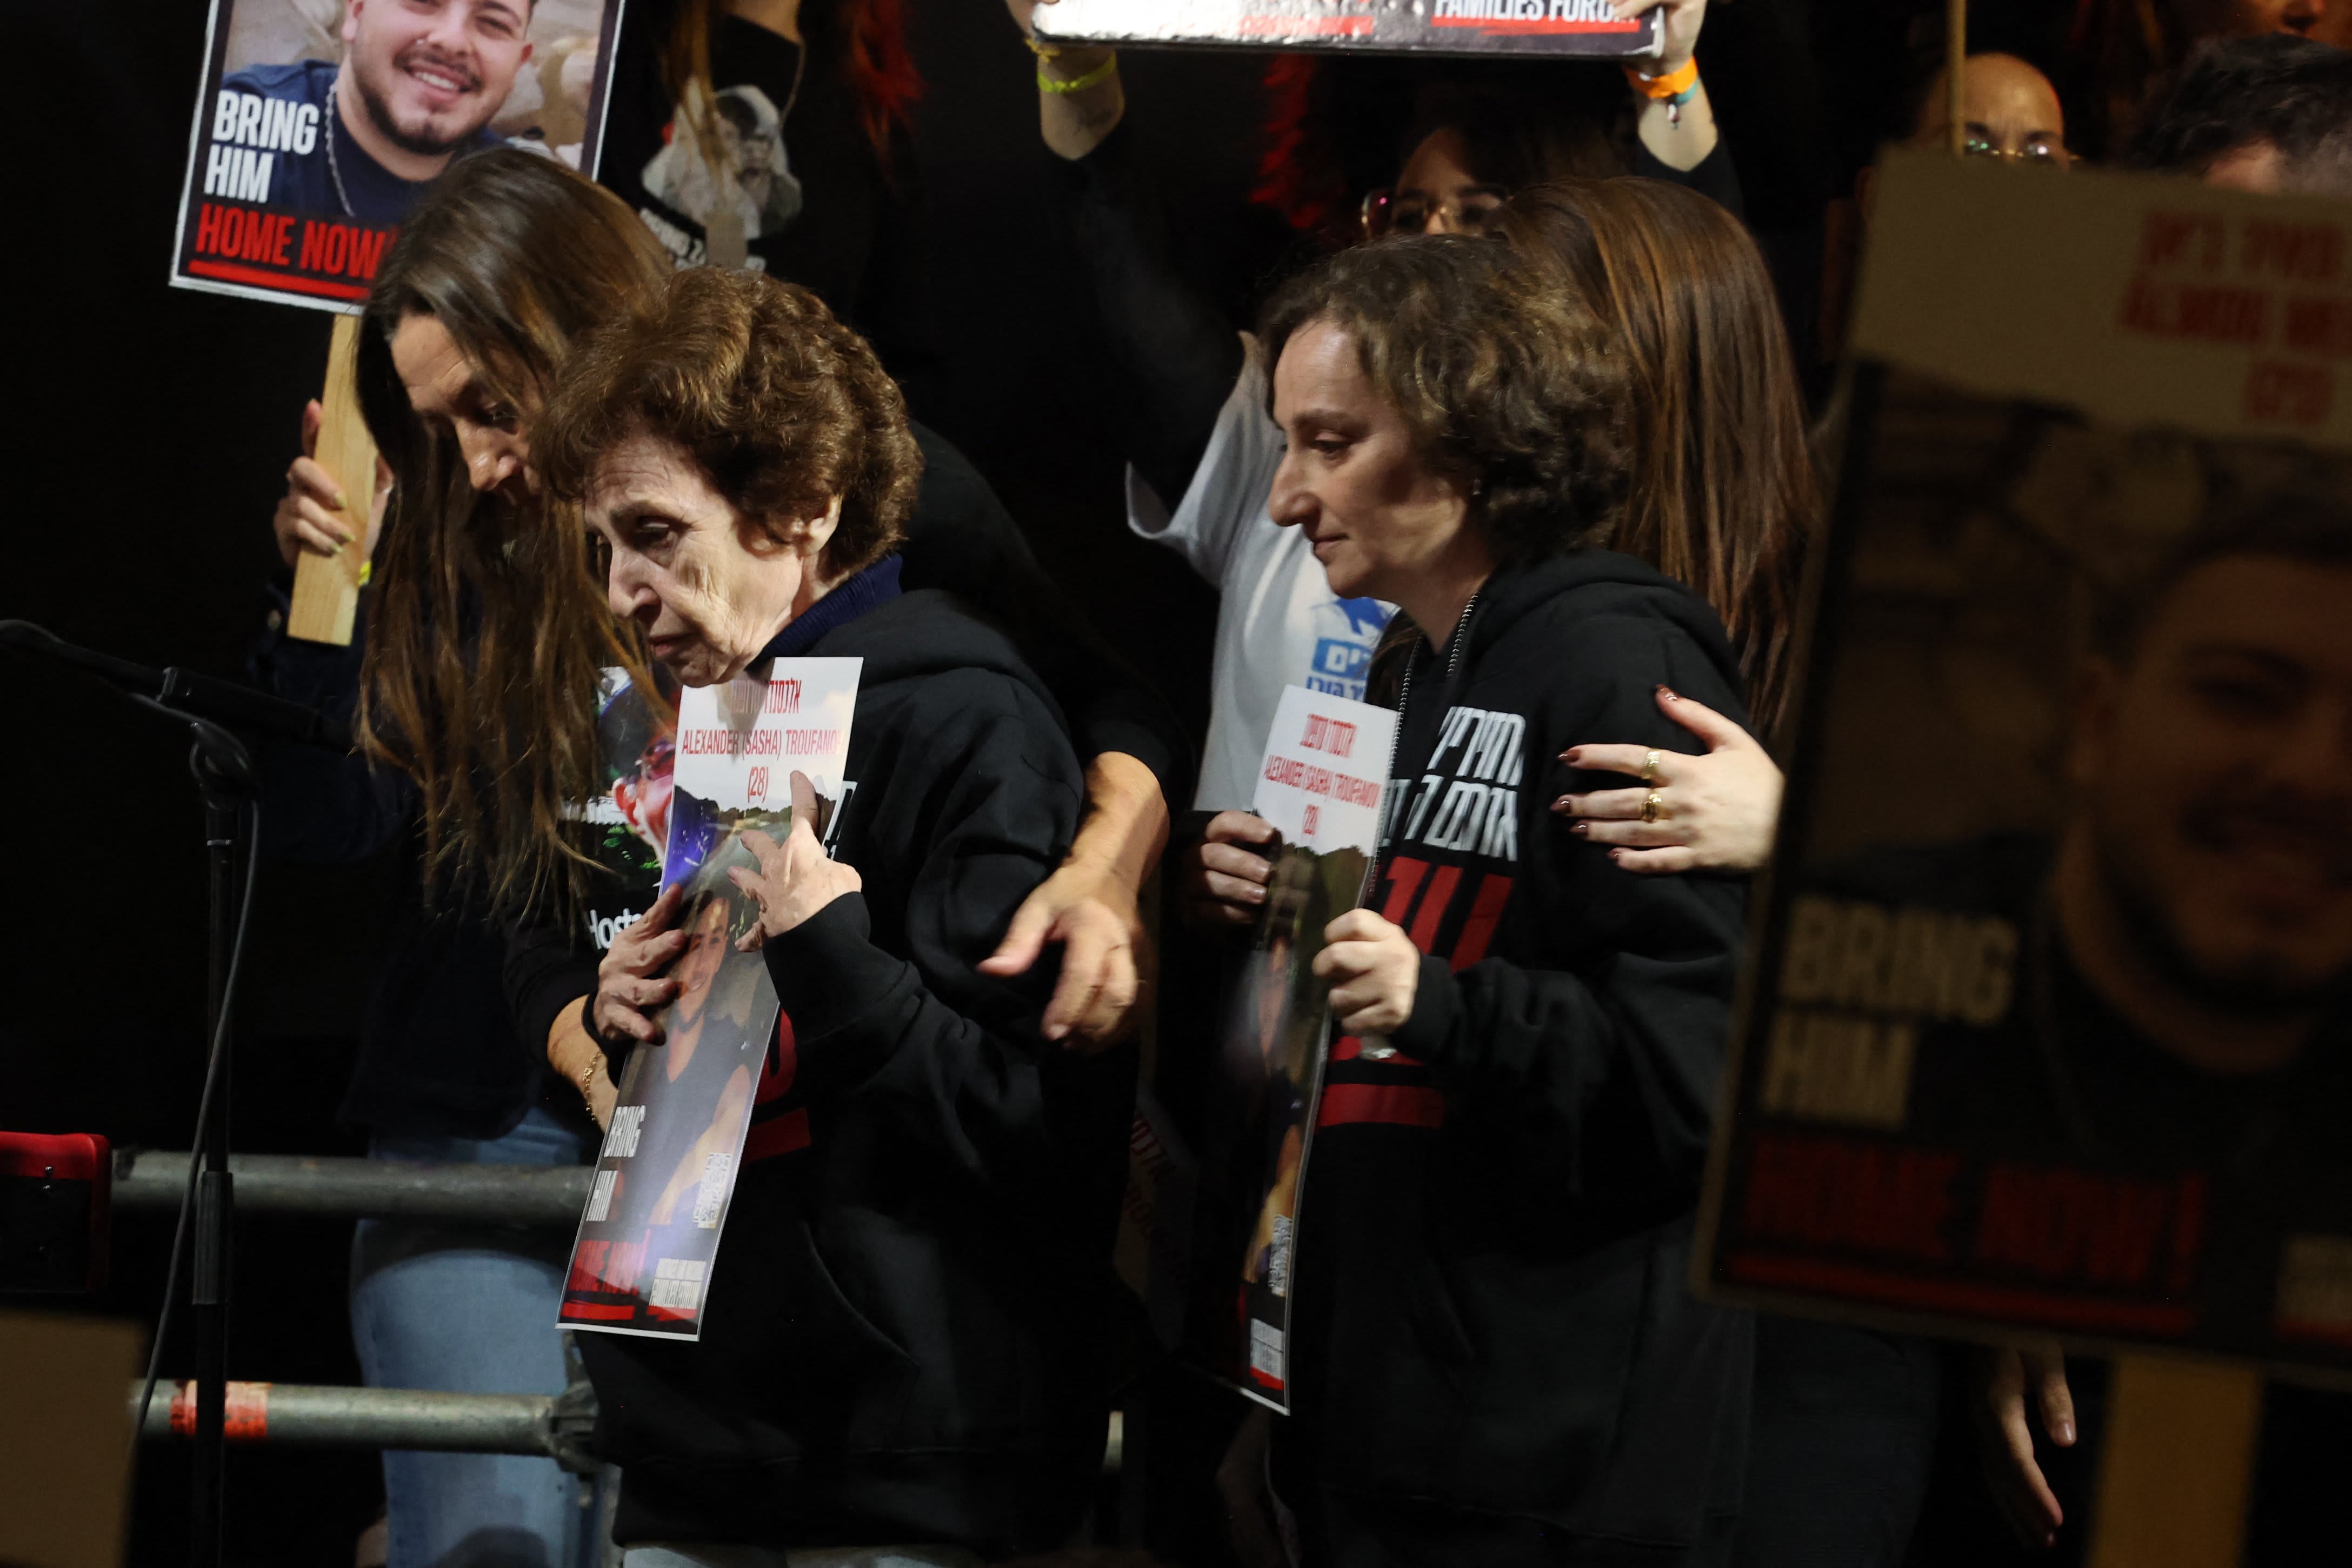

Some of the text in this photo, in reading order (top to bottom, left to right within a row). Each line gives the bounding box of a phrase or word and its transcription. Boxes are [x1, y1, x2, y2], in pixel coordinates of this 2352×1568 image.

[1549, 0, 1636, 23] FORU
[213, 90, 319, 155] BRING
[204, 144, 274, 204] HIM
[195, 203, 296, 266] HOME
[682, 729, 739, 755] ALEXANDER
[741, 729, 782, 761] (SASHA)
[747, 766, 769, 804] (28)
[1776, 892, 2022, 1031] BRING
[1758, 1010, 1922, 1131] HIM
[603, 1105, 647, 1158] BRING
